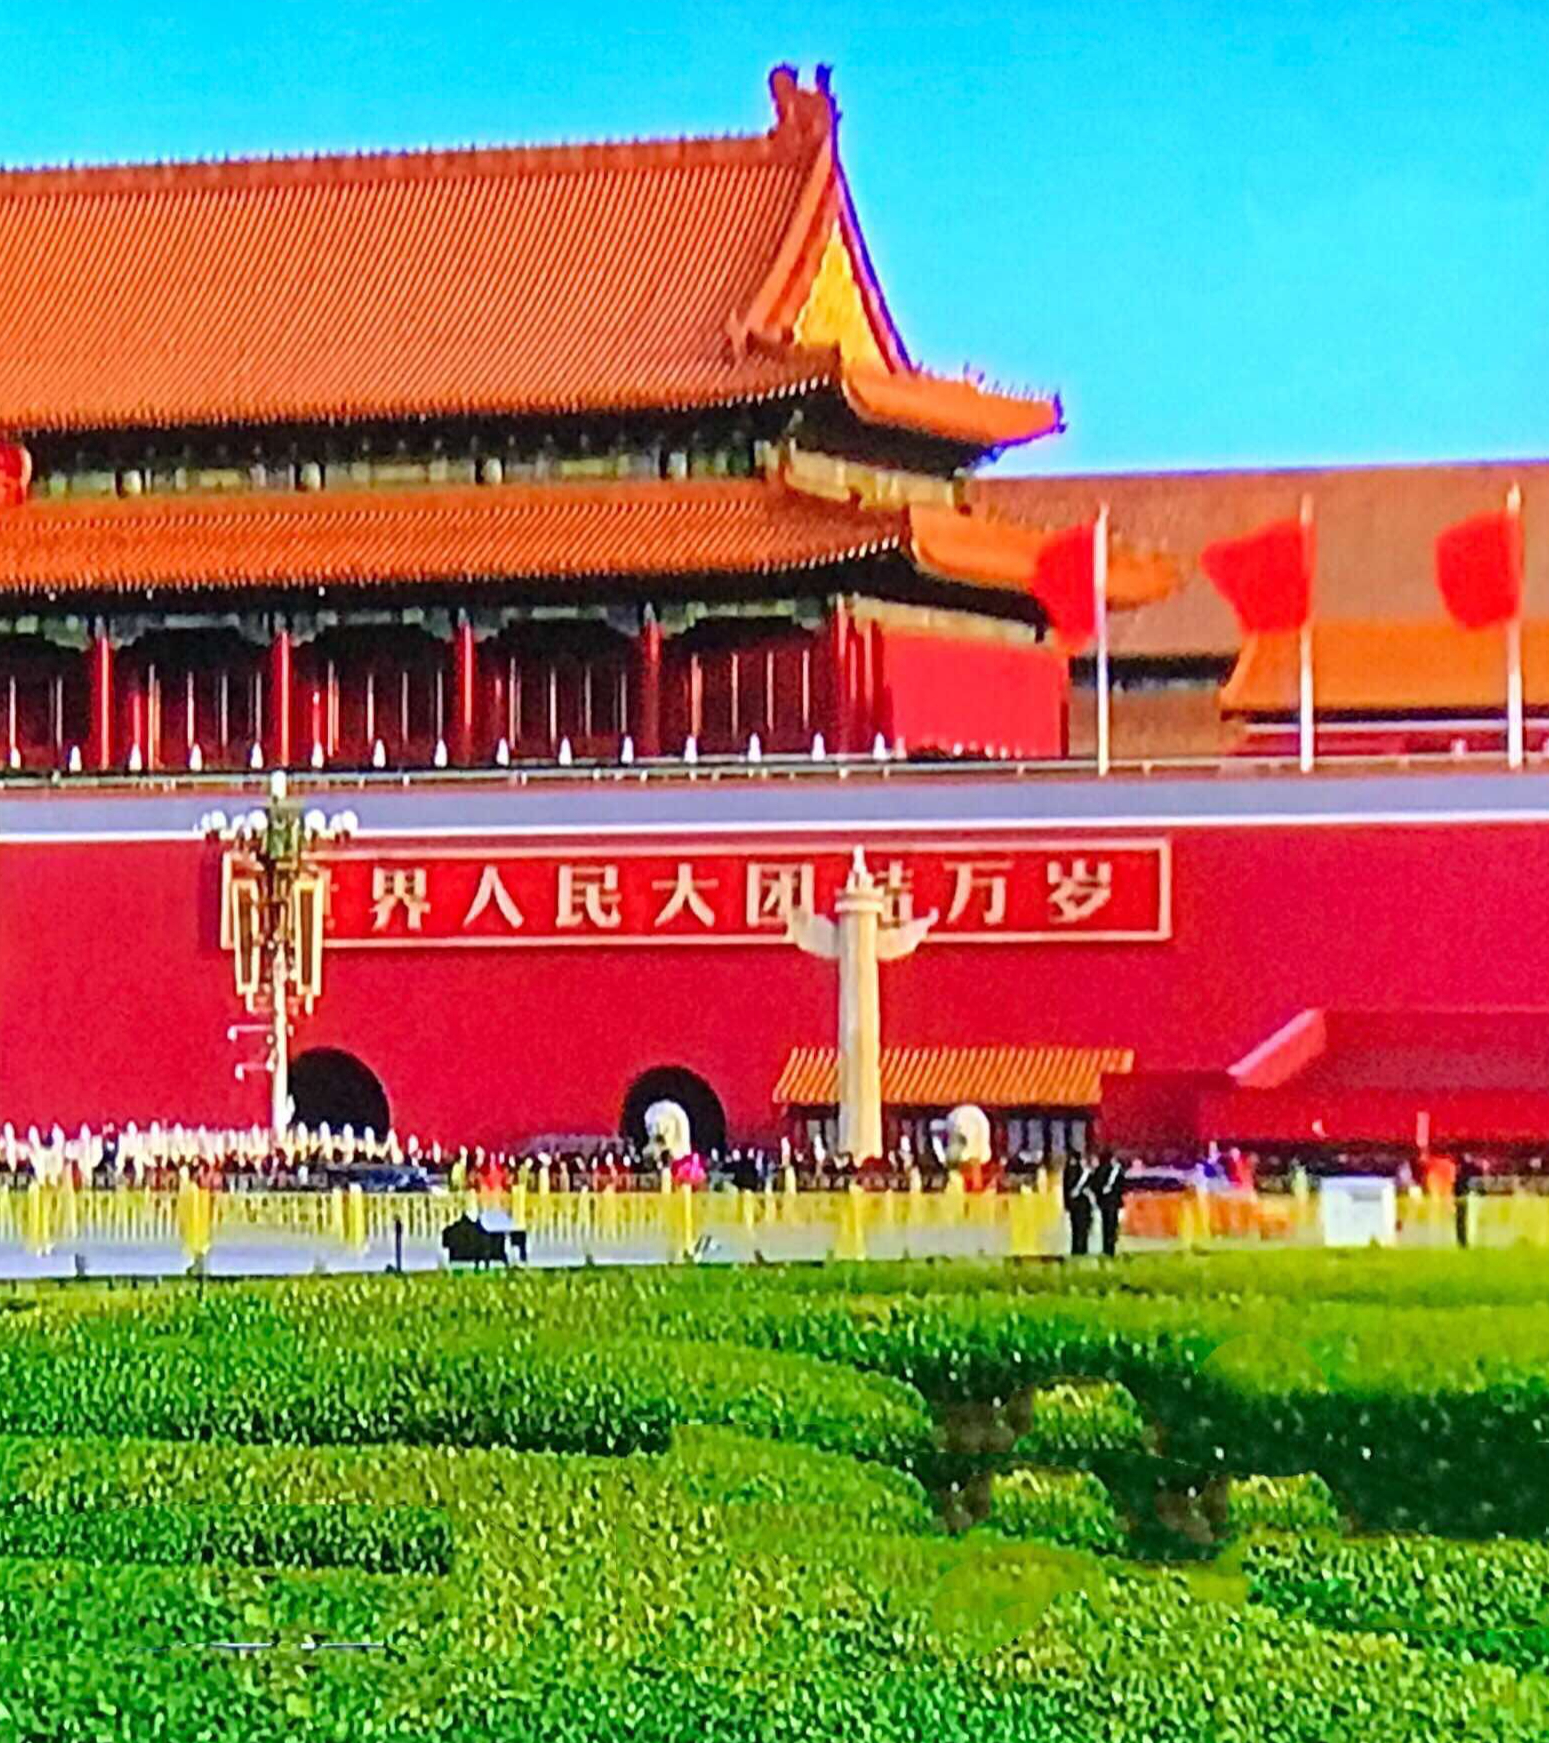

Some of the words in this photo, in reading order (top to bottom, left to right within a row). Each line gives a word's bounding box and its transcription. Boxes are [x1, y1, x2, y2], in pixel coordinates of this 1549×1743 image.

[272, 858, 1114, 932] 界人民大团万岁
